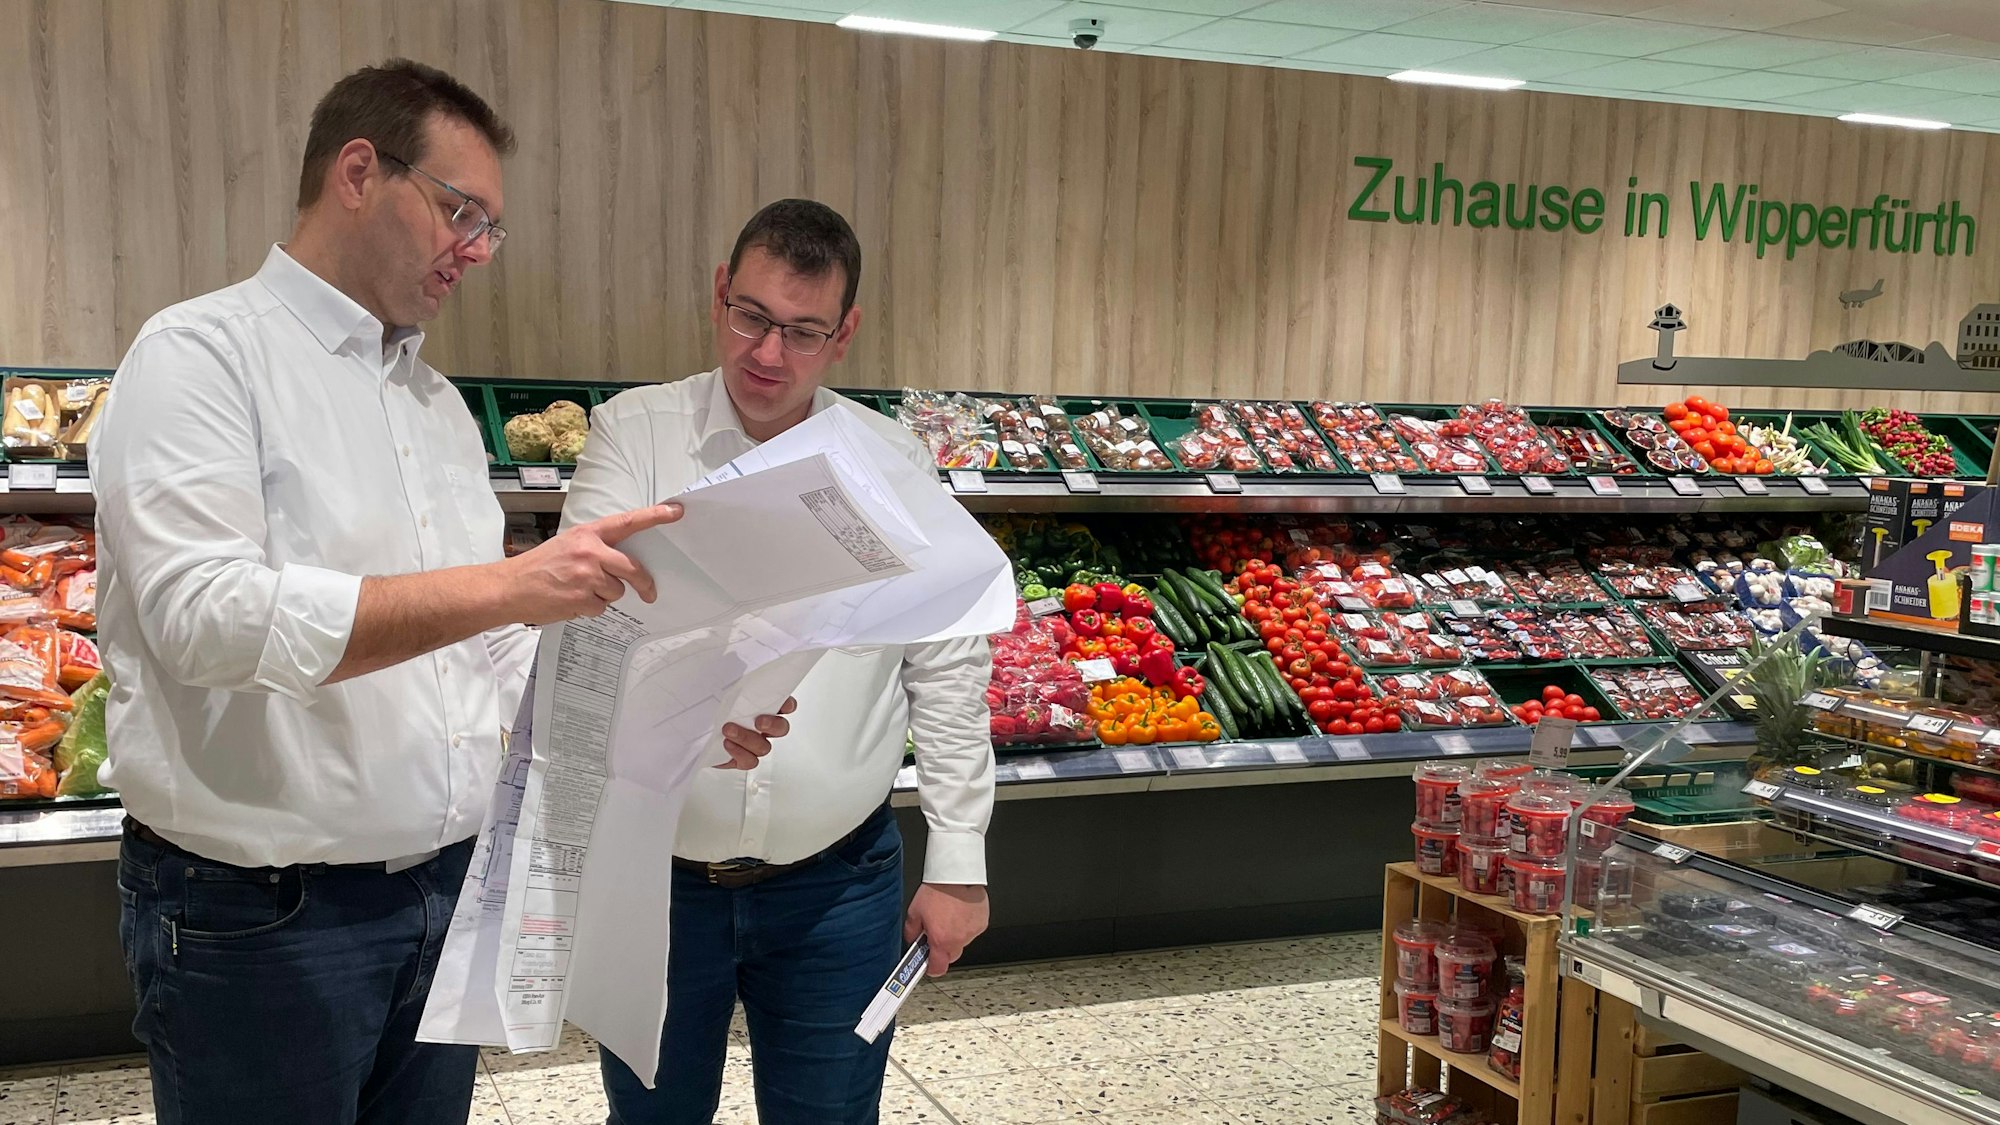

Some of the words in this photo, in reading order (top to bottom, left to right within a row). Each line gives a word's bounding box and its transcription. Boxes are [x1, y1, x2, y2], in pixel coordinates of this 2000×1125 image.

[1348, 156, 1605, 234] Zuhause
[1624, 177, 1669, 238] in
[1690, 181, 1976, 260] Wipperfürth
[1870, 494, 1900, 507] ANANAS-
[1911, 498, 1939, 509] ANANAS-
[1869, 504, 1898, 516] SCHNEIDER
[1910, 508, 1938, 517] SCHNEIDER
[1949, 523, 1984, 535] EDEKA
[1894, 584, 1921, 596] ANANAS-
[1893, 594, 1927, 608] SCHNEIDER
[1923, 718, 1943, 729] 2.49
[1553, 746, 1568, 759] 5,99
